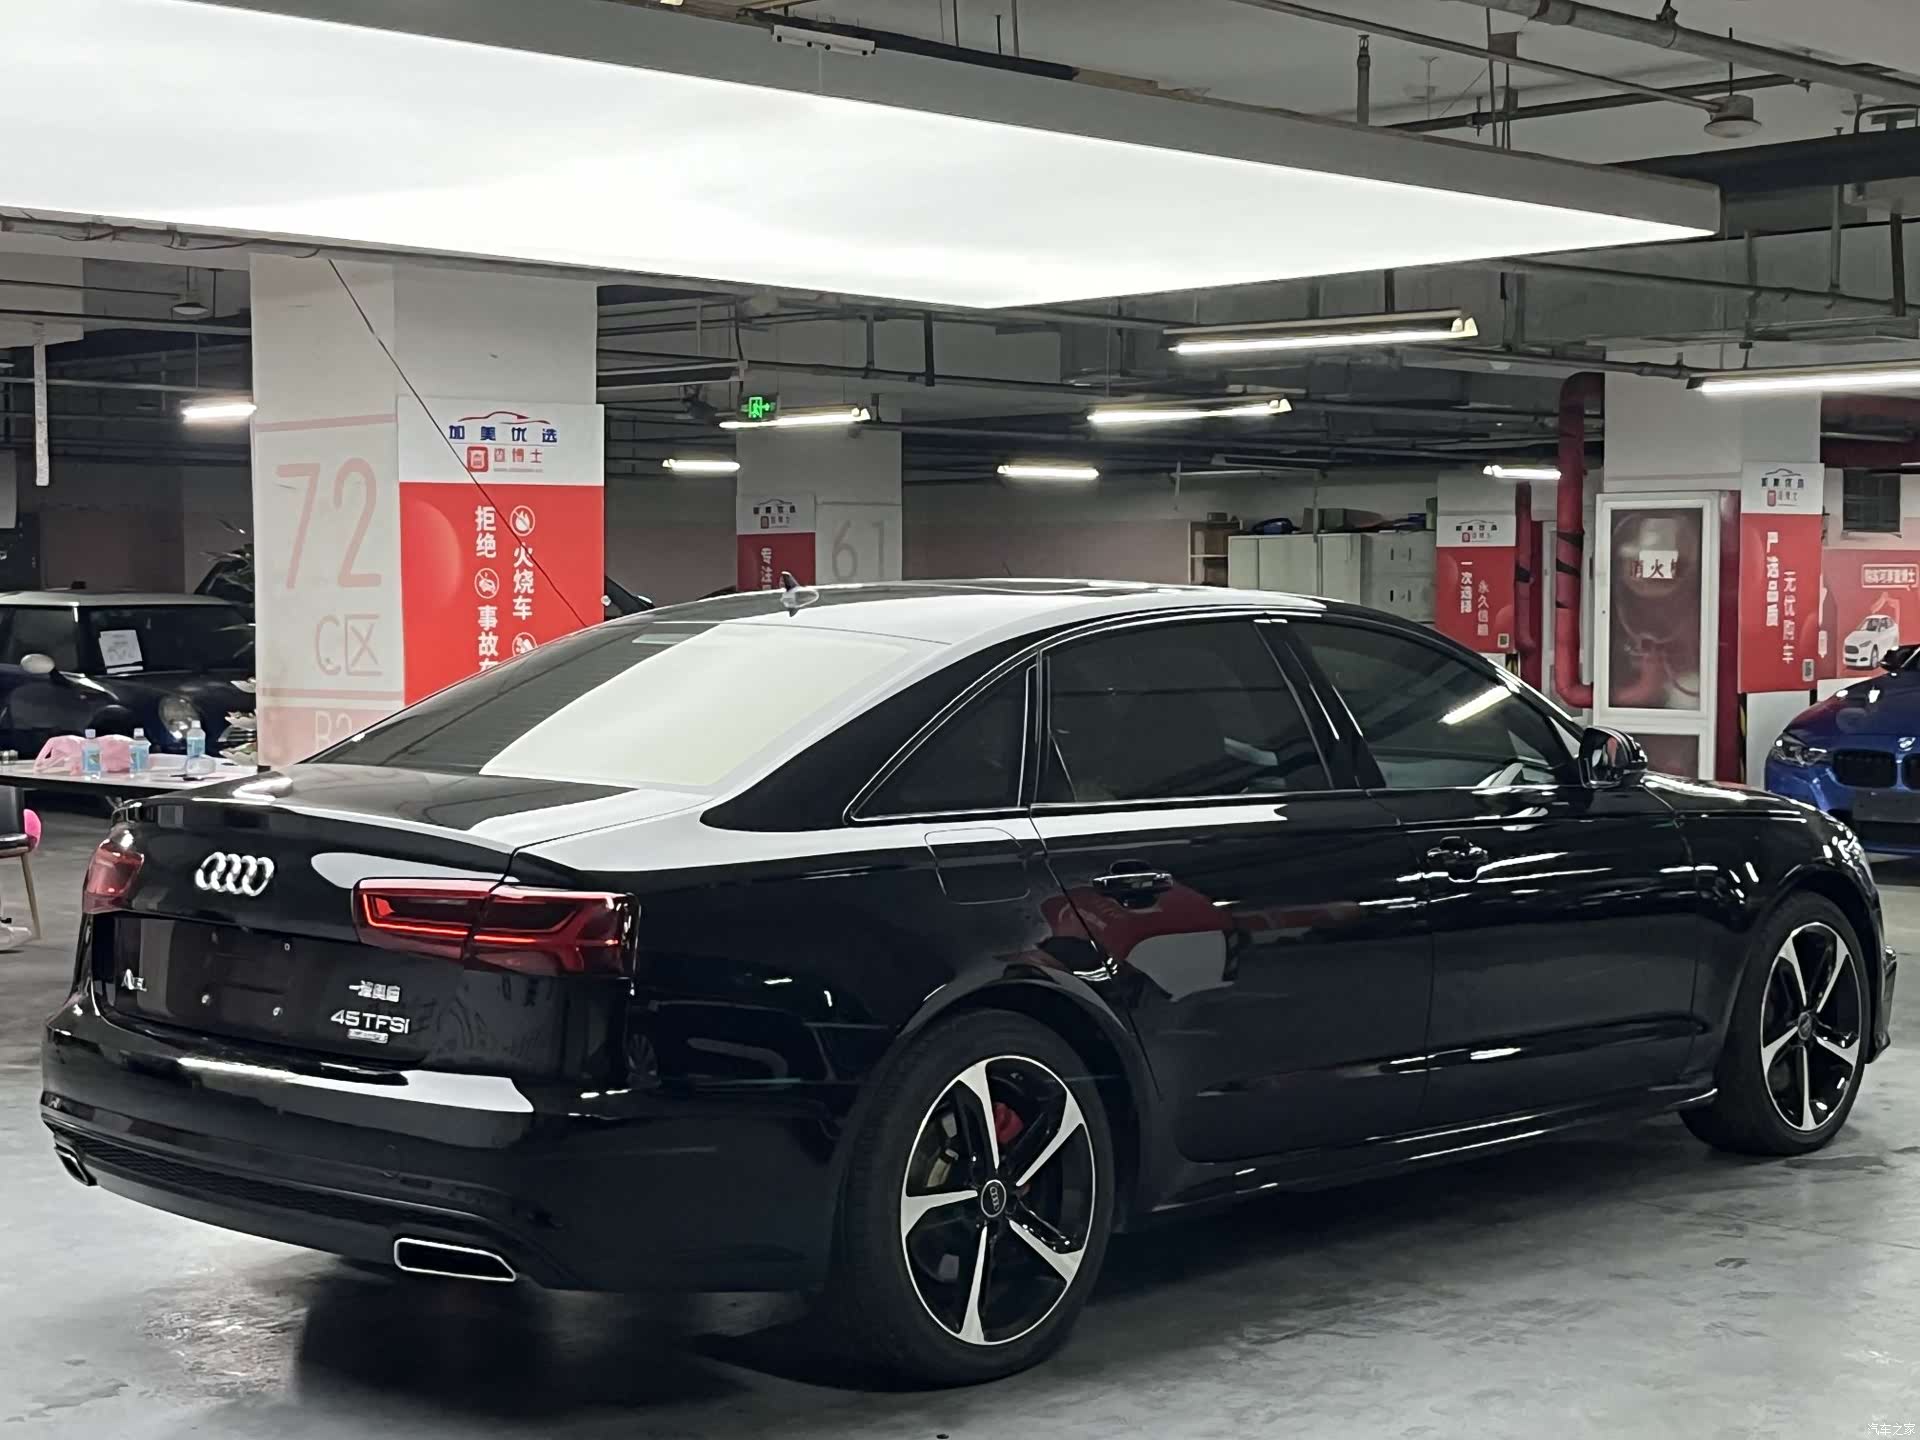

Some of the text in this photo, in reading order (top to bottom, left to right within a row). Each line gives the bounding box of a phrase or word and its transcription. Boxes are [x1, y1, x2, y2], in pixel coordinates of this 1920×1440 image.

[275, 457, 382, 590] 72
[475, 505, 497, 559] 拒绝
[831, 519, 886, 582] 61
[512, 542, 535, 621] 火烧车
[316, 614, 382, 677] C区
